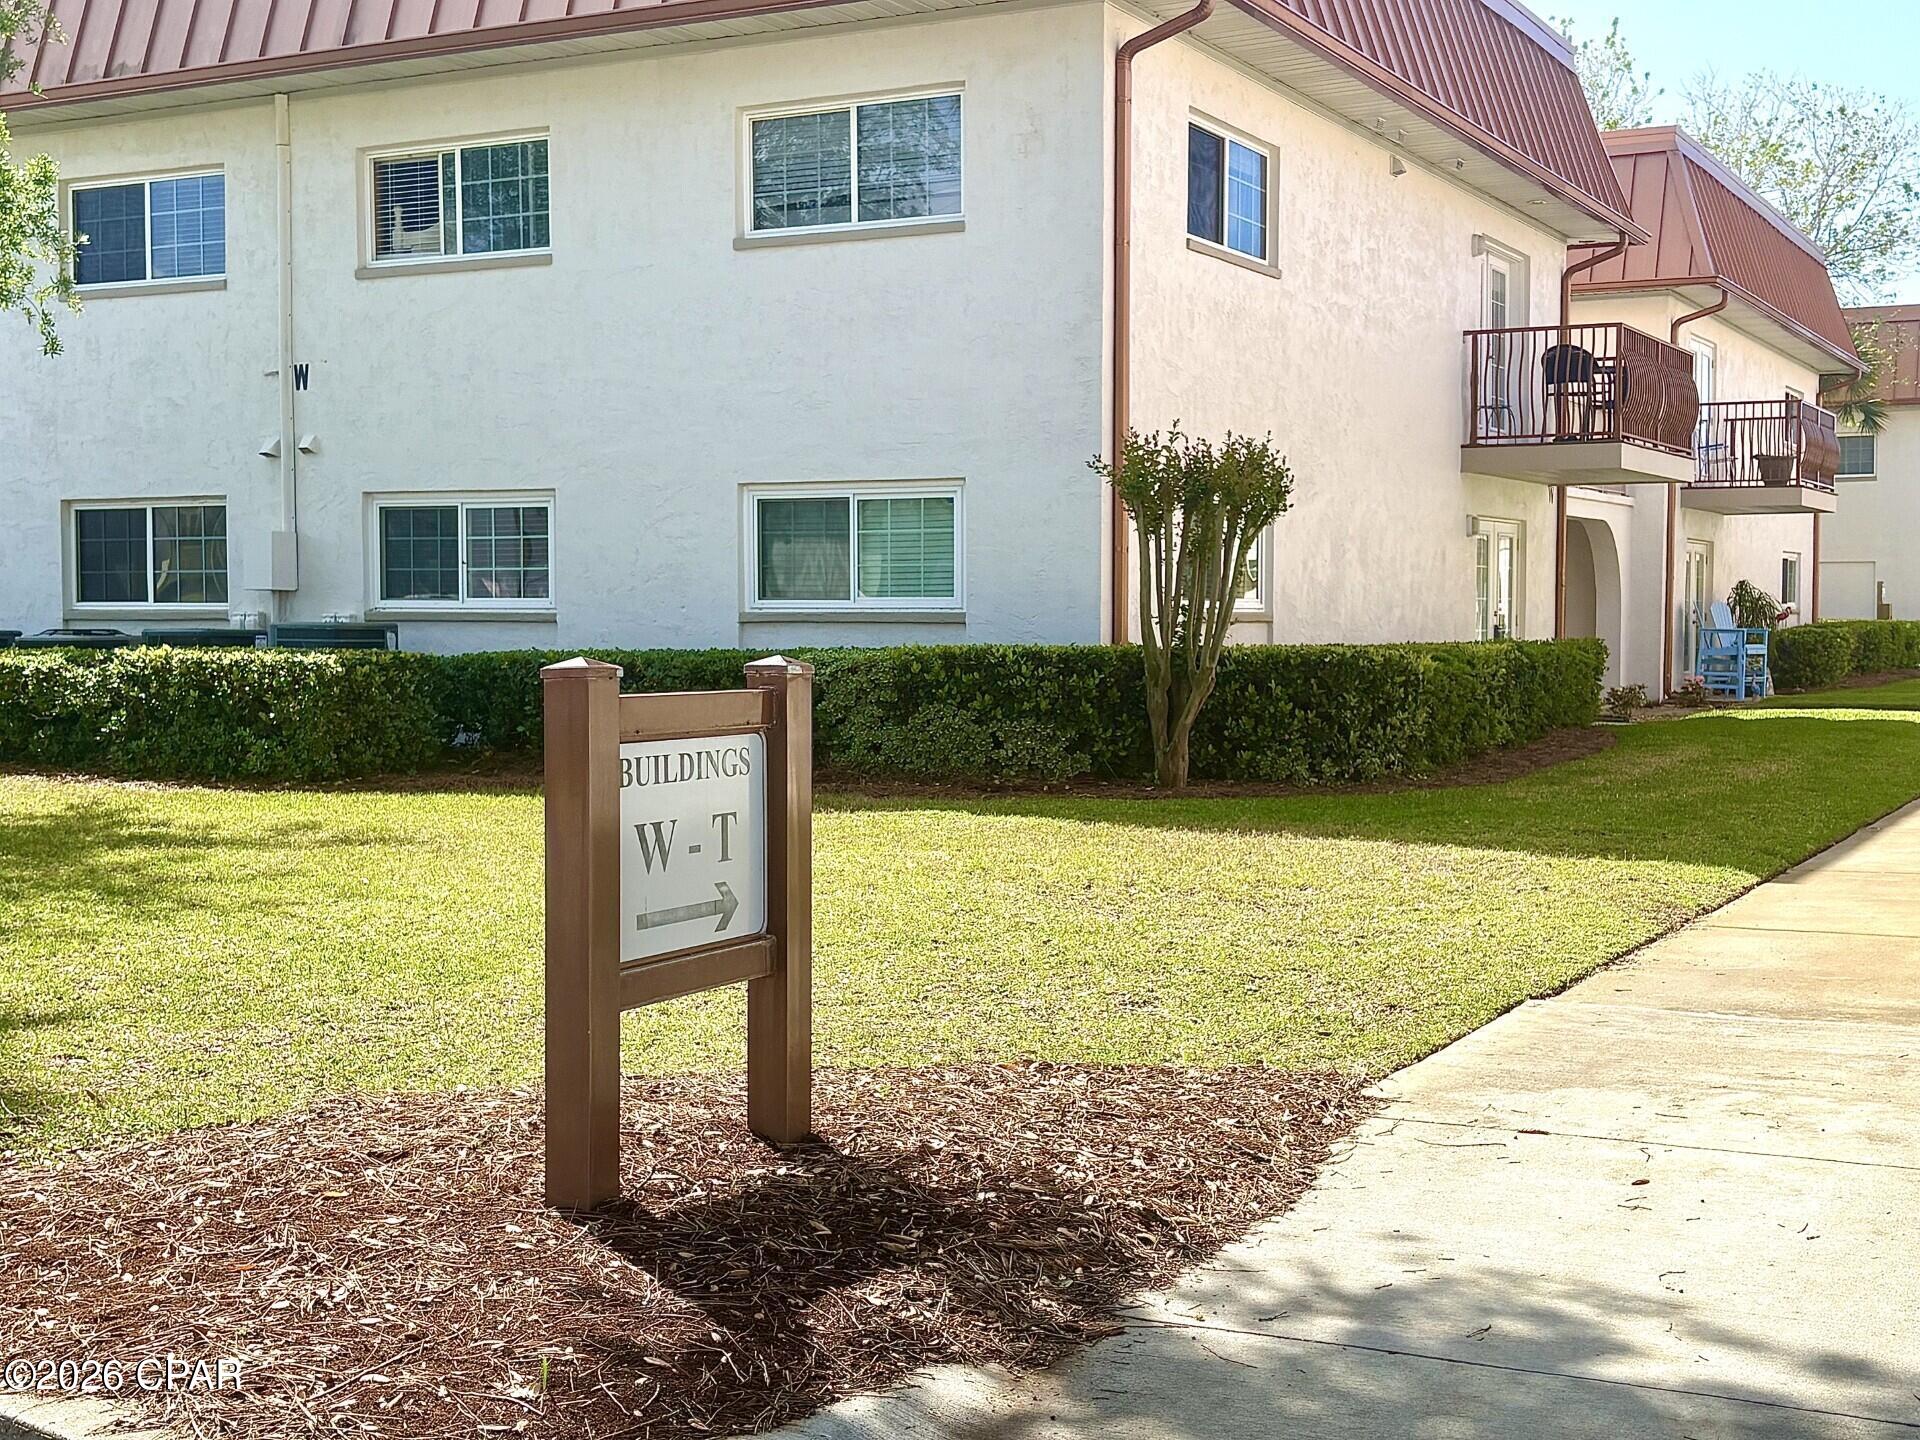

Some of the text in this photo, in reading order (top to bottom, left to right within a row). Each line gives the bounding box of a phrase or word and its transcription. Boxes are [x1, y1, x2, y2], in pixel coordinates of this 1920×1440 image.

[293, 363, 309, 391] W
[620, 747, 750, 788] BUILDINGS
[634, 819, 678, 875] W
[711, 811, 738, 863] T
